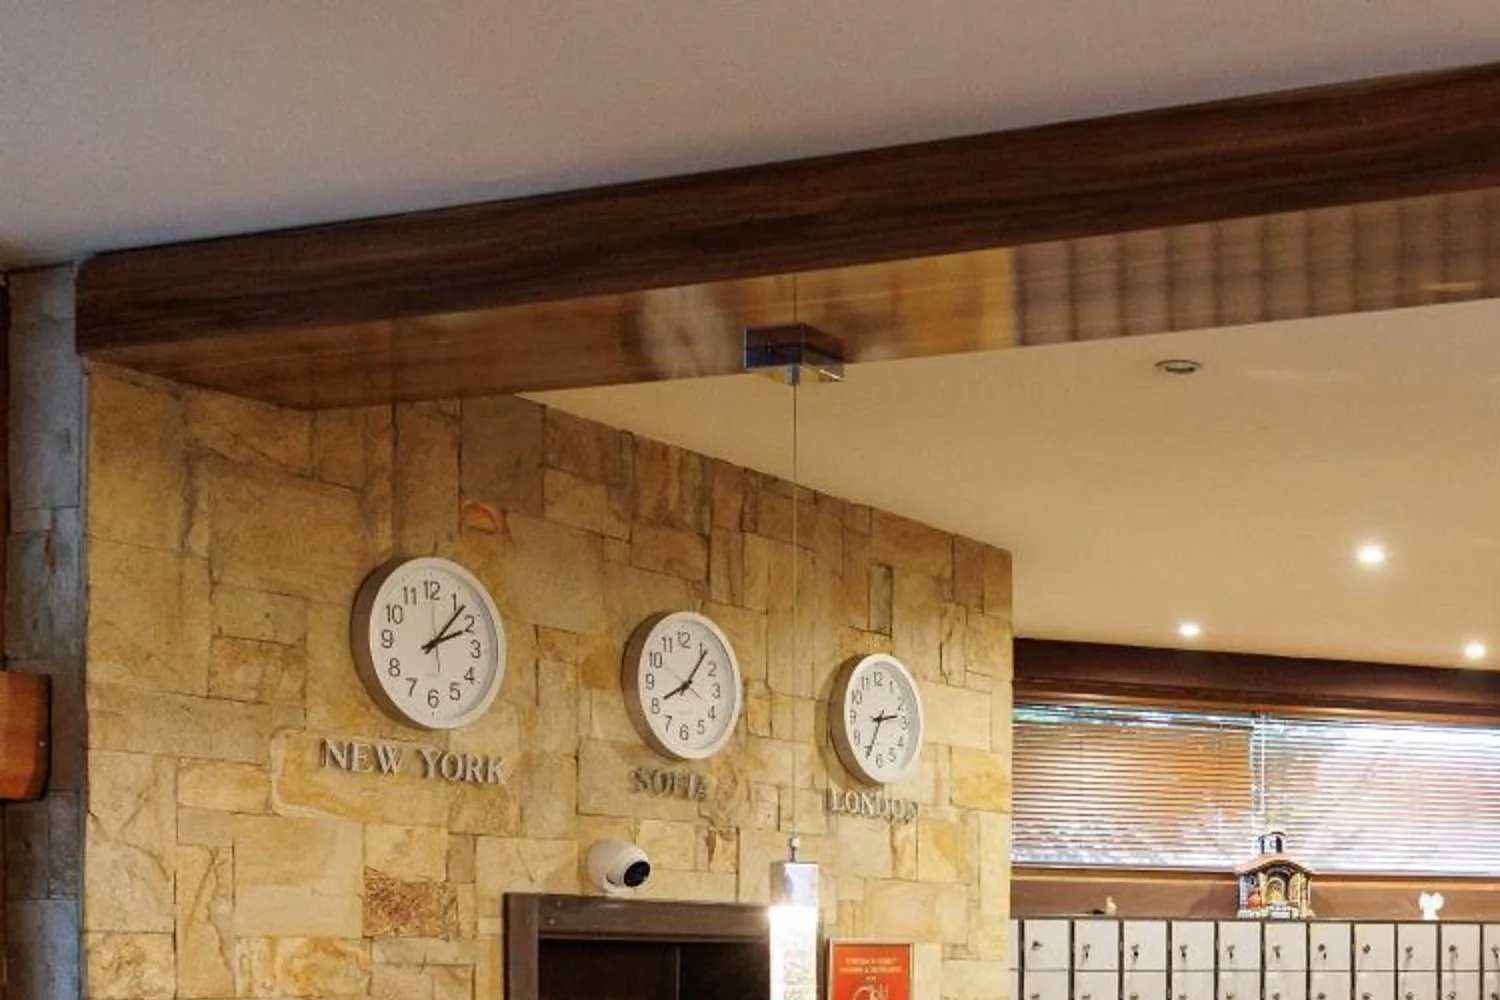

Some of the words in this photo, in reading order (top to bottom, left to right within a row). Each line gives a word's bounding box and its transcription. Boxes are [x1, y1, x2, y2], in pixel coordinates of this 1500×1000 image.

[403, 587, 417, 605] 11
[423, 580, 441, 600] 12
[451, 592, 458, 612] 1
[385, 603, 404, 624] 10
[464, 615, 475, 634] 2
[381, 629, 394, 649] 9
[662, 636, 673, 653] 11
[677, 631, 691, 649] 12
[470, 639, 481, 659] 3
[388, 658, 400, 677] 8
[649, 651, 663, 668] 10
[464, 667, 475, 684] 4
[707, 661, 717, 677] 2
[406, 677, 418, 697] 7
[645, 673, 655, 690] 9
[711, 682, 721, 699] 3
[427, 689, 439, 708] 6
[450, 682, 461, 701] 5
[650, 697, 660, 714] 8
[708, 705, 716, 720] 4
[664, 715, 672, 732] 7
[679, 724, 689, 741] 6
[697, 720, 705, 735] 5
[320, 737, 403, 776] NEW
[420, 746, 509, 785] YORK
